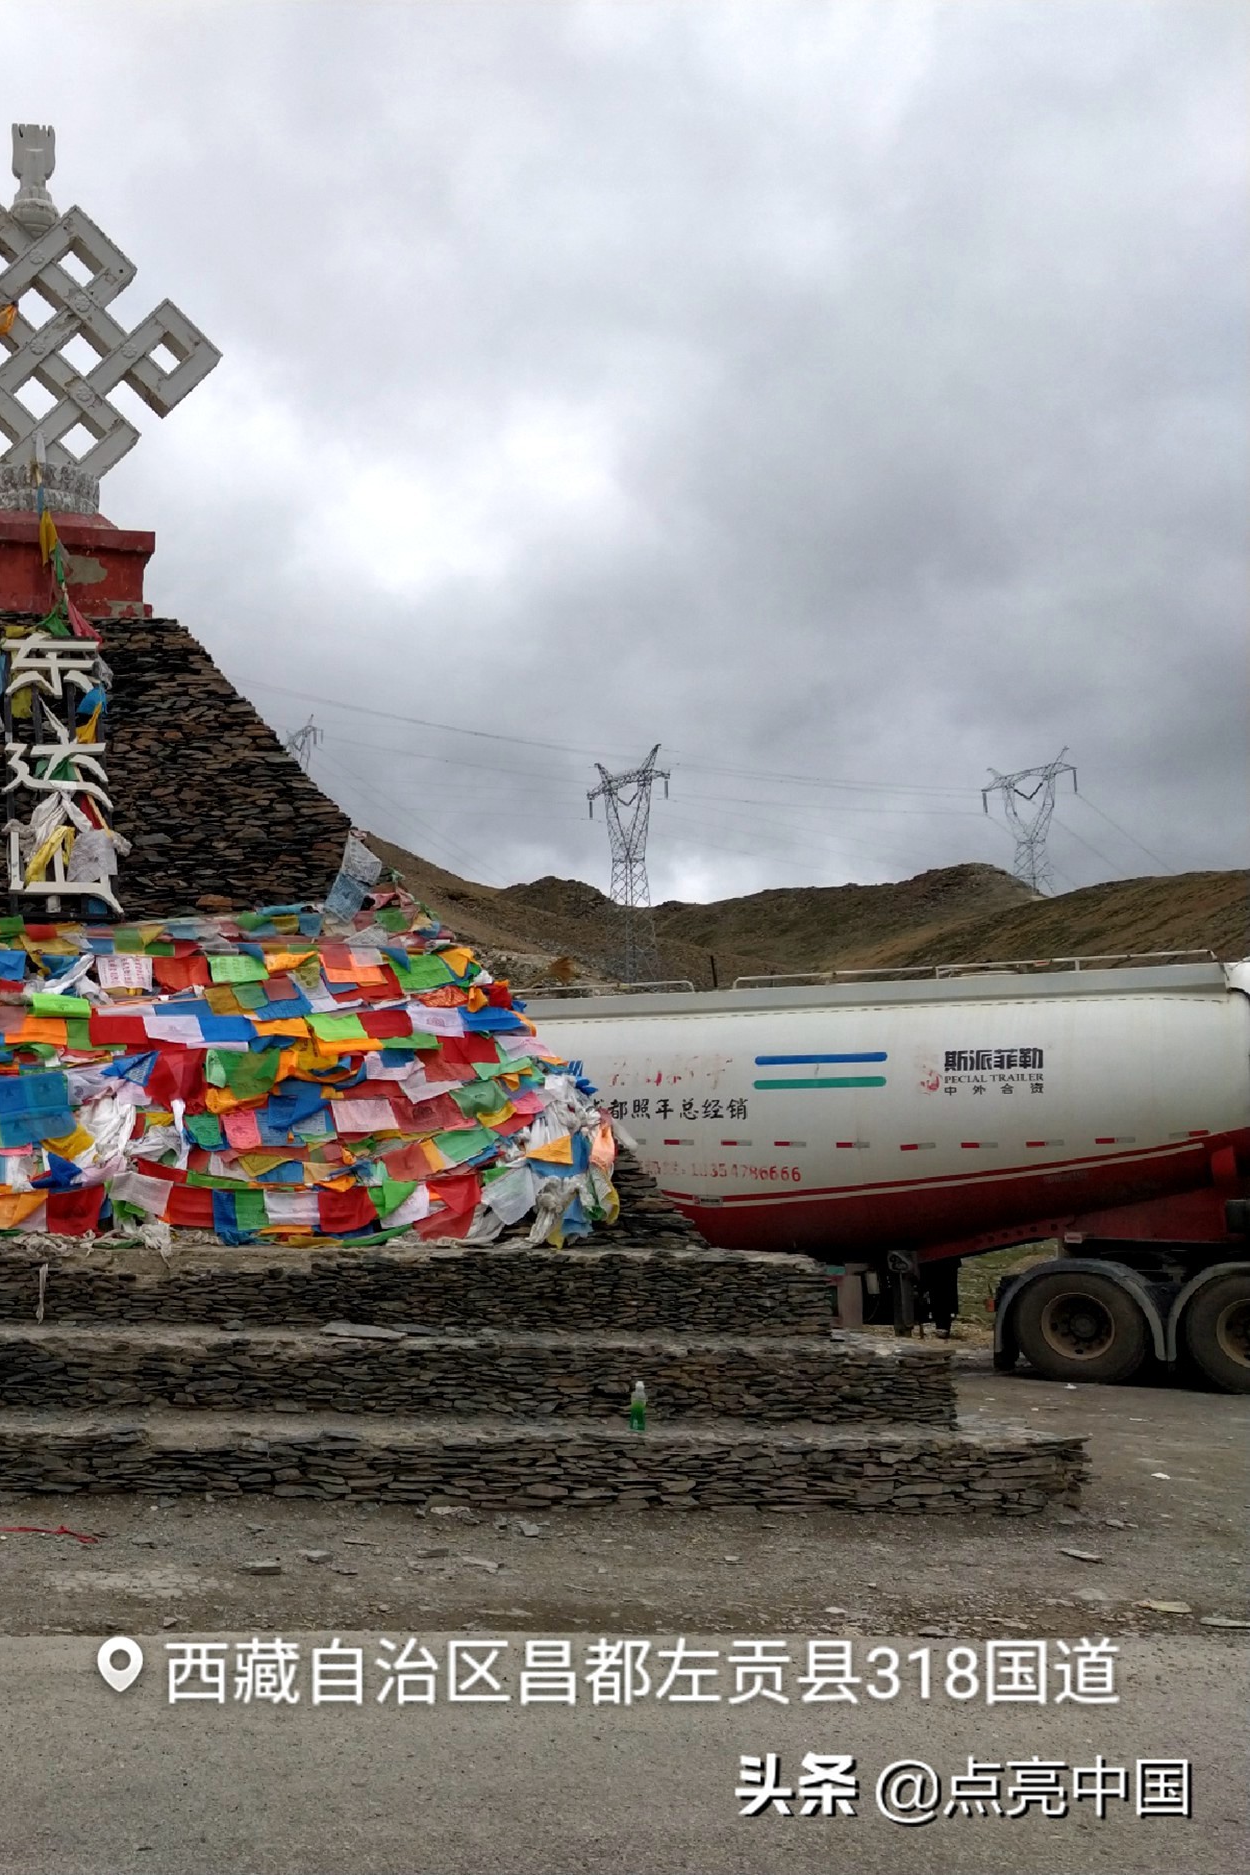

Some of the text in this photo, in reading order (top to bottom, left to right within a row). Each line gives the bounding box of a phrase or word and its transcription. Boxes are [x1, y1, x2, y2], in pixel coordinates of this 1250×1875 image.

[944, 1047, 1044, 1072] 斯派菲勒
[990, 1072, 1044, 1082] TRAILER
